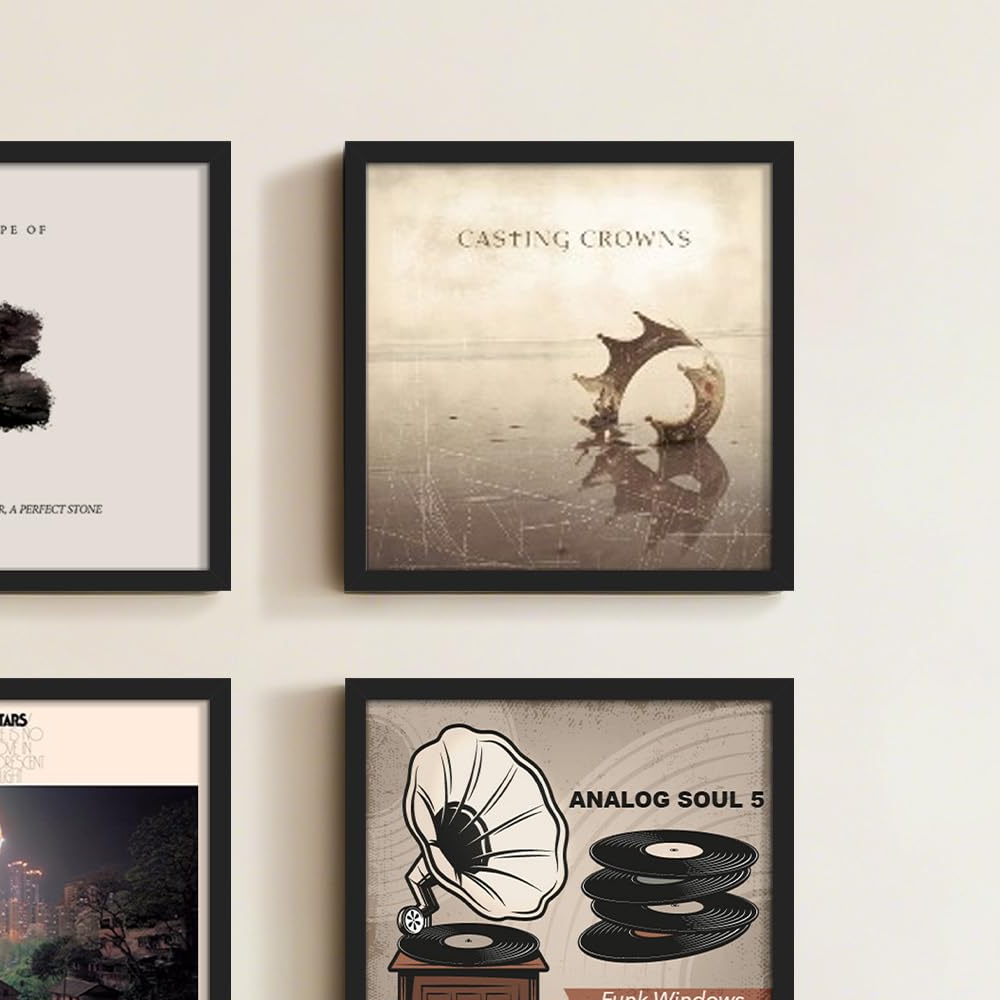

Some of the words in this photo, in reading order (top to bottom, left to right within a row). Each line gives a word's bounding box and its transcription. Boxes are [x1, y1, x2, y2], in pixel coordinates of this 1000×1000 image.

[26, 224, 46, 235] OF
[457, 229, 570, 253] CASTING
[580, 229, 693, 249] CROWNS
[9, 504, 18, 515] A
[19, 504, 67, 515] PERFECT
[66, 504, 104, 515] STONE
[22, 727, 44, 741] NO
[568, 790, 670, 809] ANALOG
[677, 790, 743, 809] SOUL
[751, 790, 765, 809] 5
